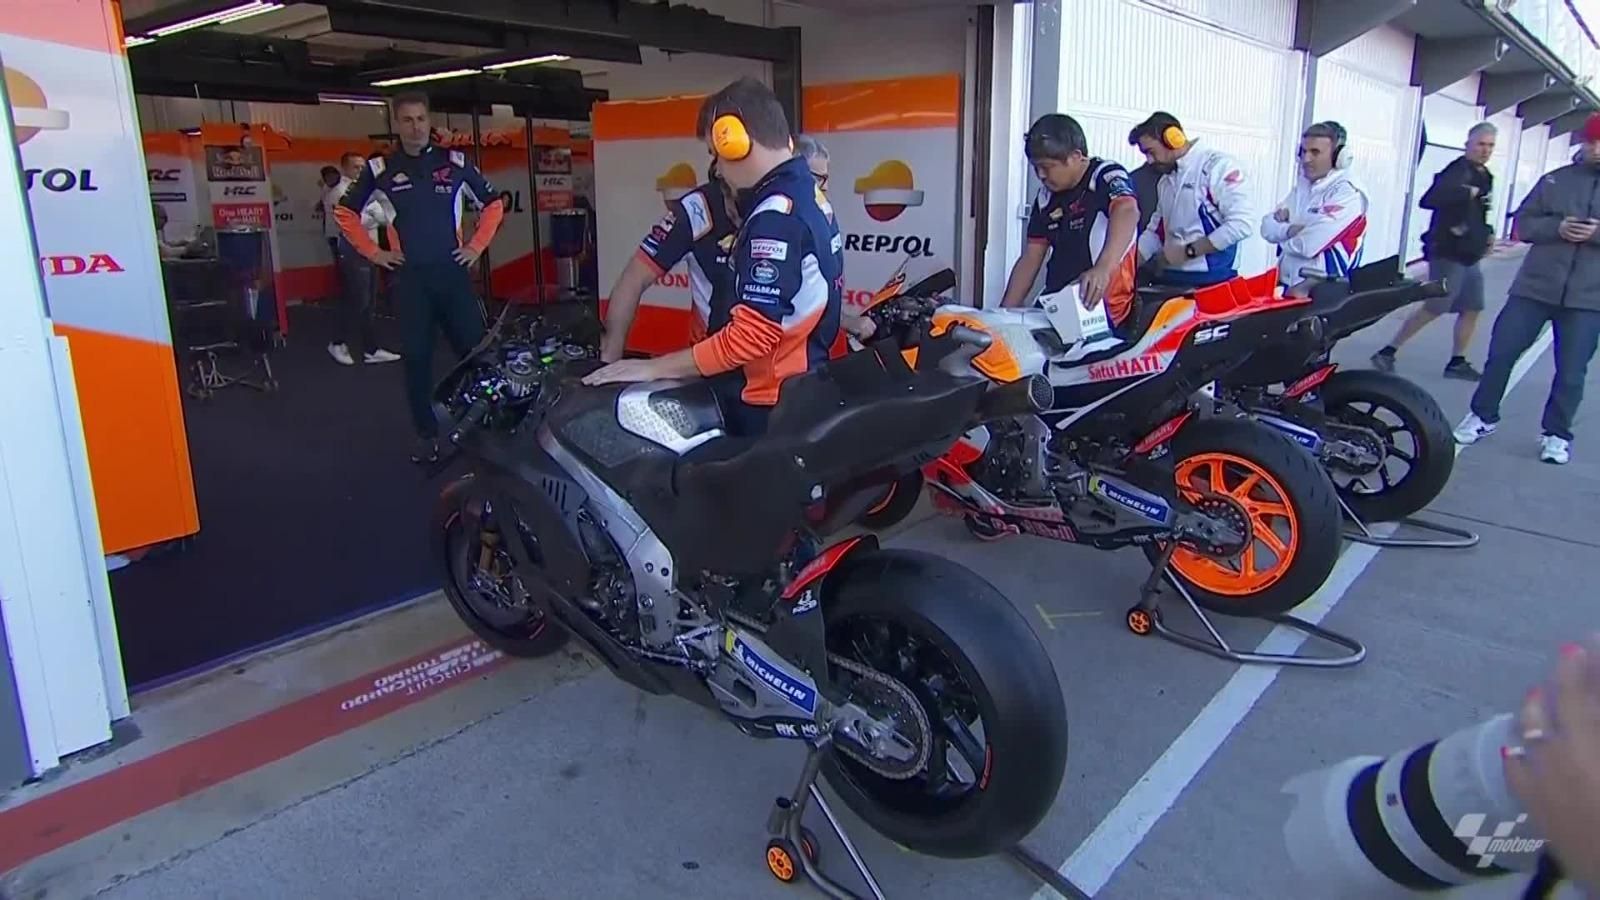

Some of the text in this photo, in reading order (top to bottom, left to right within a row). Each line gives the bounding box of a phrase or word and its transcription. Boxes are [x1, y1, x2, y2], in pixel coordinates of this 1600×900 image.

[223, 186, 257, 196] HRC
[844, 233, 934, 258] REPSOL
[1194, 325, 1230, 345] SC
[1088, 364, 1116, 380] Satu
[1108, 490, 1161, 515] MICHELIN
[406, 662, 472, 697] CIRCUIT
[745, 654, 807, 701] MICHELIN
[775, 723, 799, 736] RK
